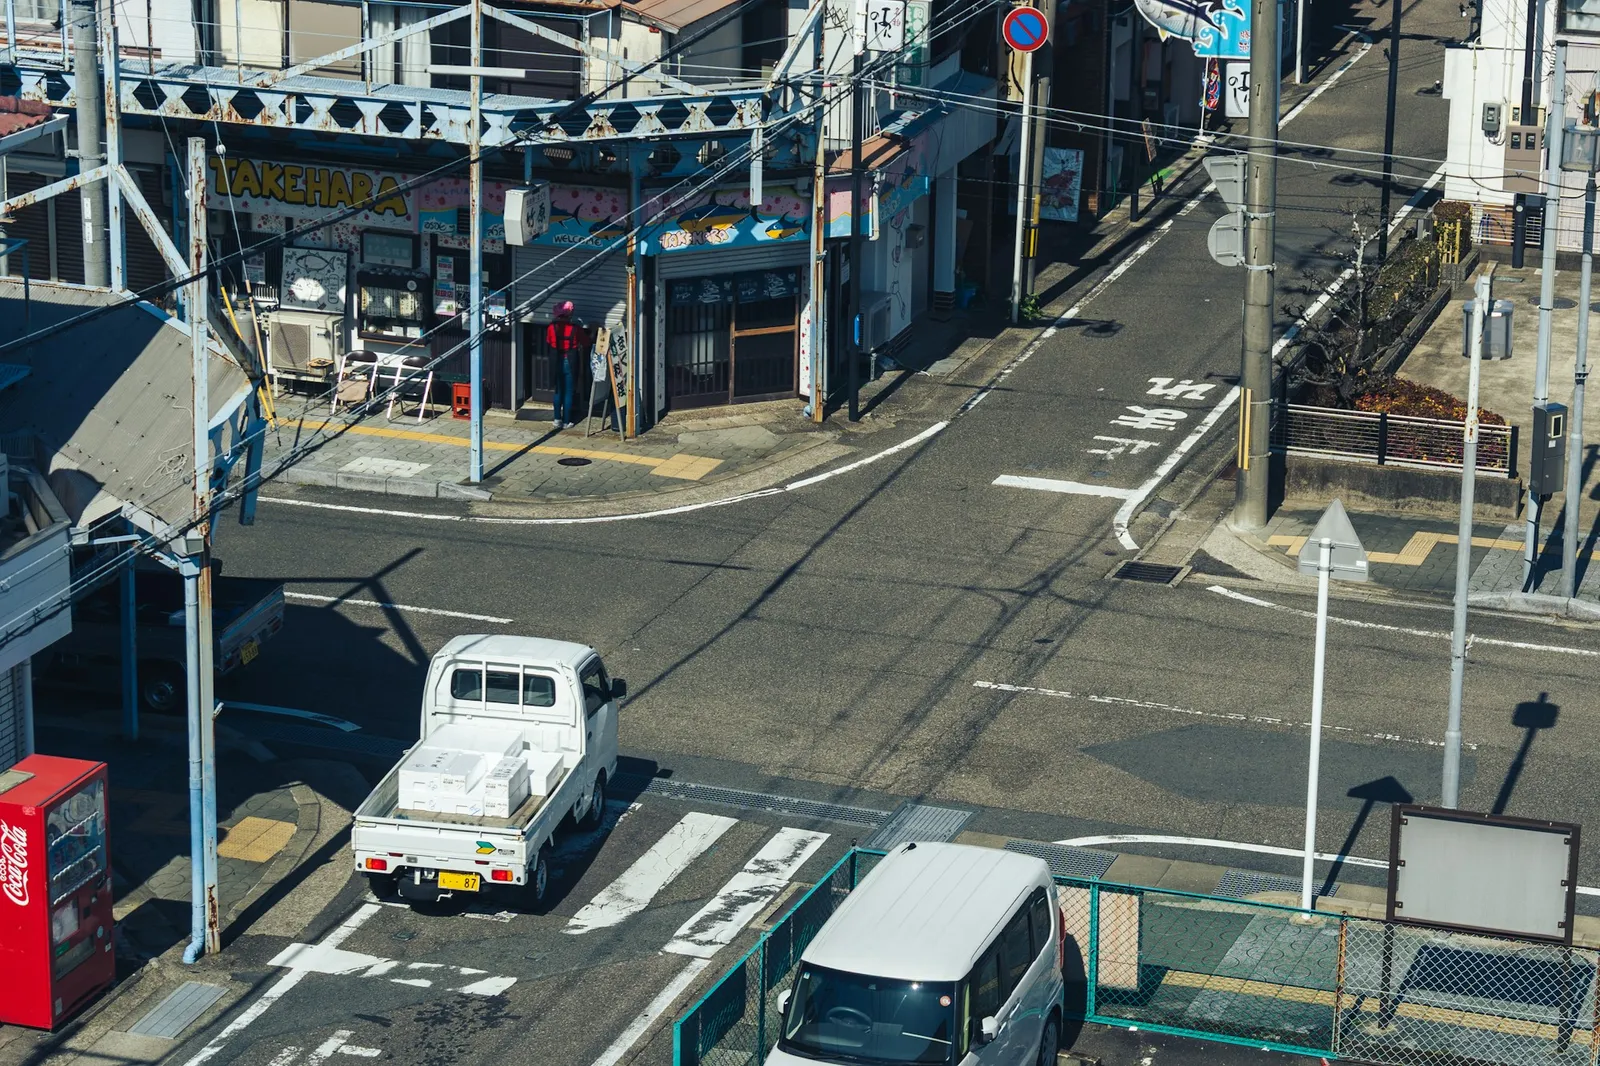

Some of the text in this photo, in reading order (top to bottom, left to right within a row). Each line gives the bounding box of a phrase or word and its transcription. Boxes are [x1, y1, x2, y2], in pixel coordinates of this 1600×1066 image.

[208, 156, 408, 217] TAKEHARA
[526, 202, 546, 228] 竹原
[554, 235, 602, 247] WELCOME
[1087, 377, 1217, 461] 止まれ
